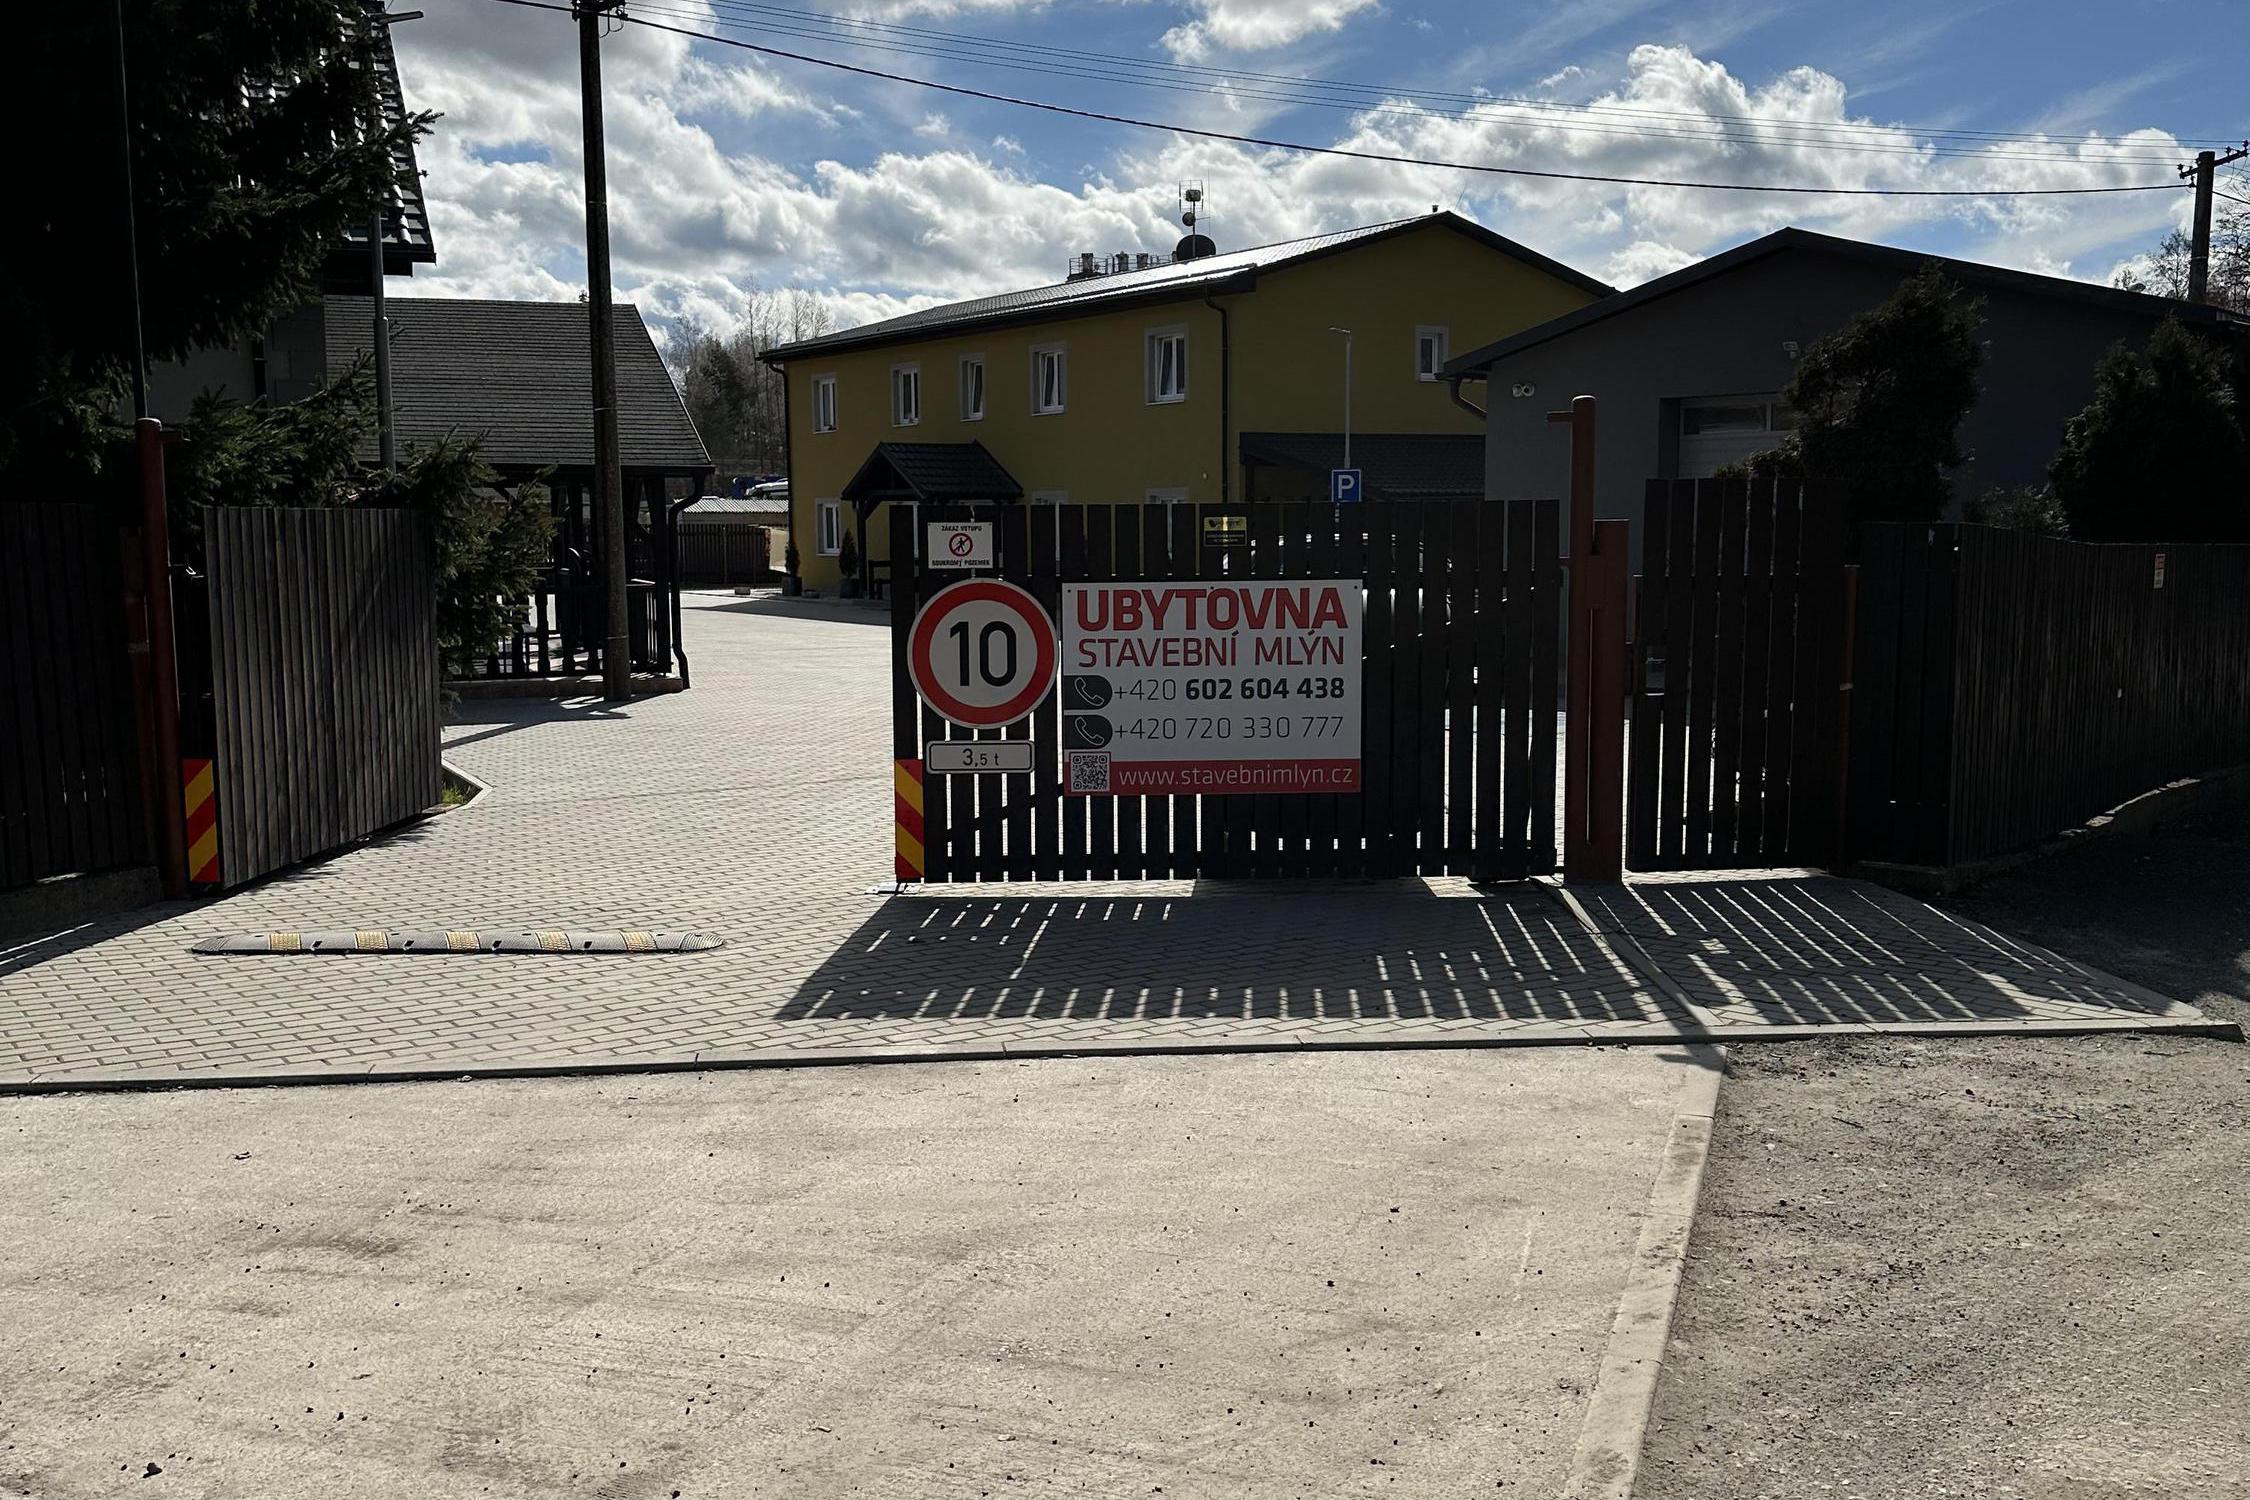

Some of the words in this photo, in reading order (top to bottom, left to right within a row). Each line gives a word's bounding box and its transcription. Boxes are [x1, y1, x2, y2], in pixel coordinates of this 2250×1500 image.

[1338, 474, 1355, 499] P
[1077, 587, 1348, 632] UBYTOVNA
[950, 621, 1017, 687] 10
[1078, 630, 1239, 668] STAVEBNÍ
[1255, 629, 1344, 666] MLÝN
[1114, 679, 1176, 701] +420
[1186, 678, 1233, 700] 602
[1240, 678, 1290, 700] 604
[1296, 677, 1345, 699] 438
[1114, 718, 1176, 740] +420
[1185, 717, 1231, 739] 720
[1243, 716, 1290, 738] 330
[1301, 716, 1343, 738] 777
[962, 748, 988, 767] 3,5
[993, 752, 999, 766] t
[1118, 763, 1354, 789] www.stavebnimlyn.cz
